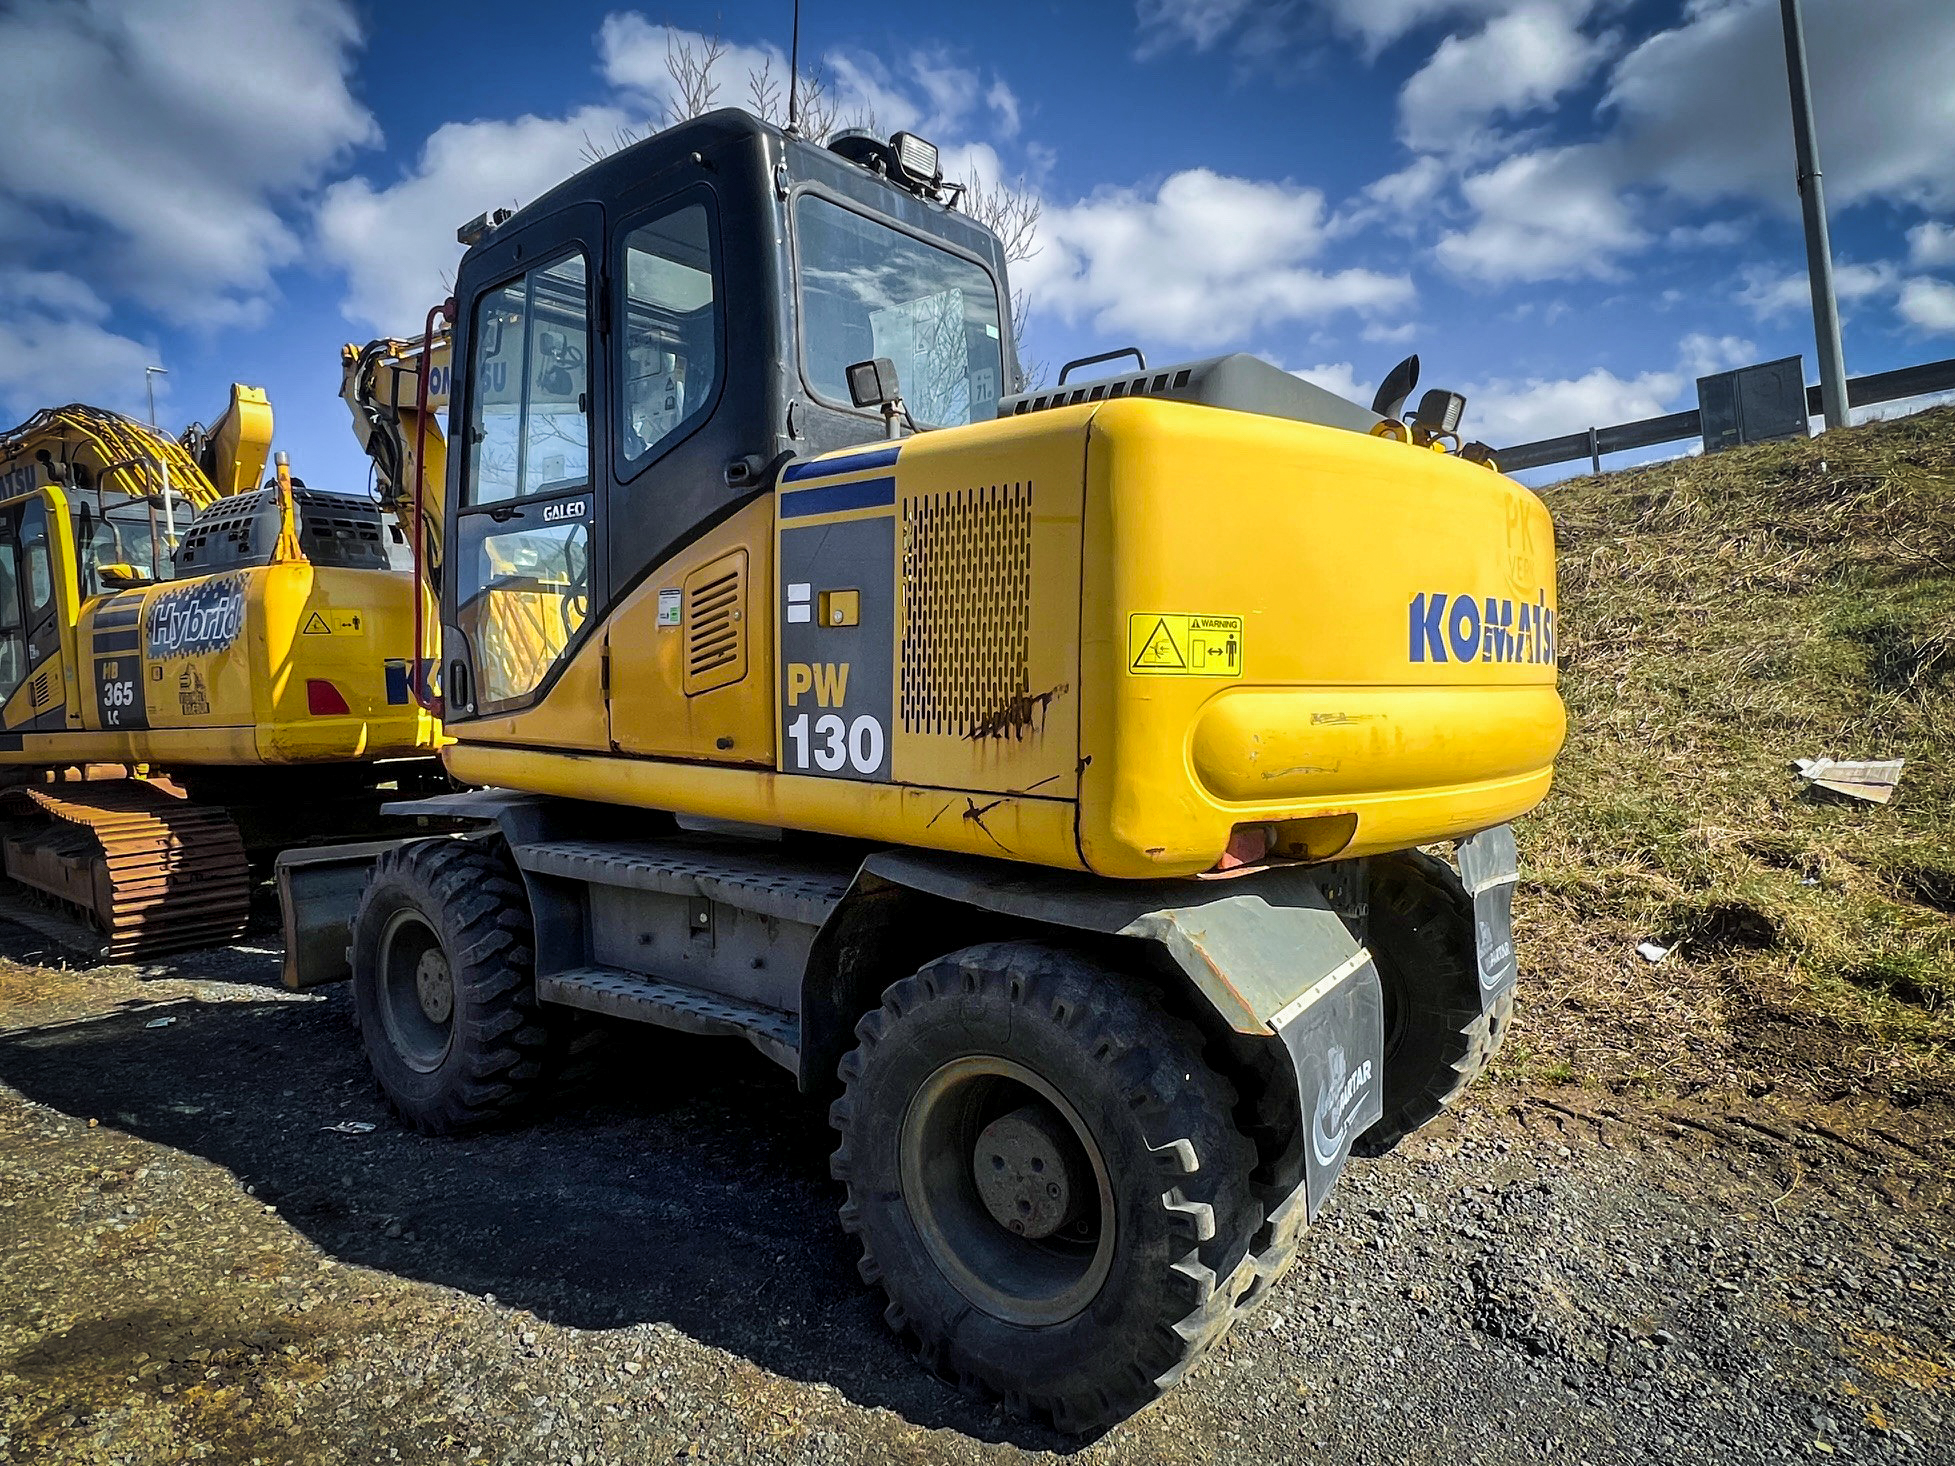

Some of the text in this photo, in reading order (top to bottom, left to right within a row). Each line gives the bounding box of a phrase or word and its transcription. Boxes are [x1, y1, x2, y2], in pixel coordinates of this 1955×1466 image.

[543, 501, 586, 521] GALEO
[152, 594, 242, 649] Hybrid
[1201, 619, 1238, 629] WARNING
[102, 661, 119, 680] HB
[103, 681, 134, 706] 365
[787, 663, 850, 708] PW
[107, 710, 120, 725] LC
[788, 713, 884, 774] 130
